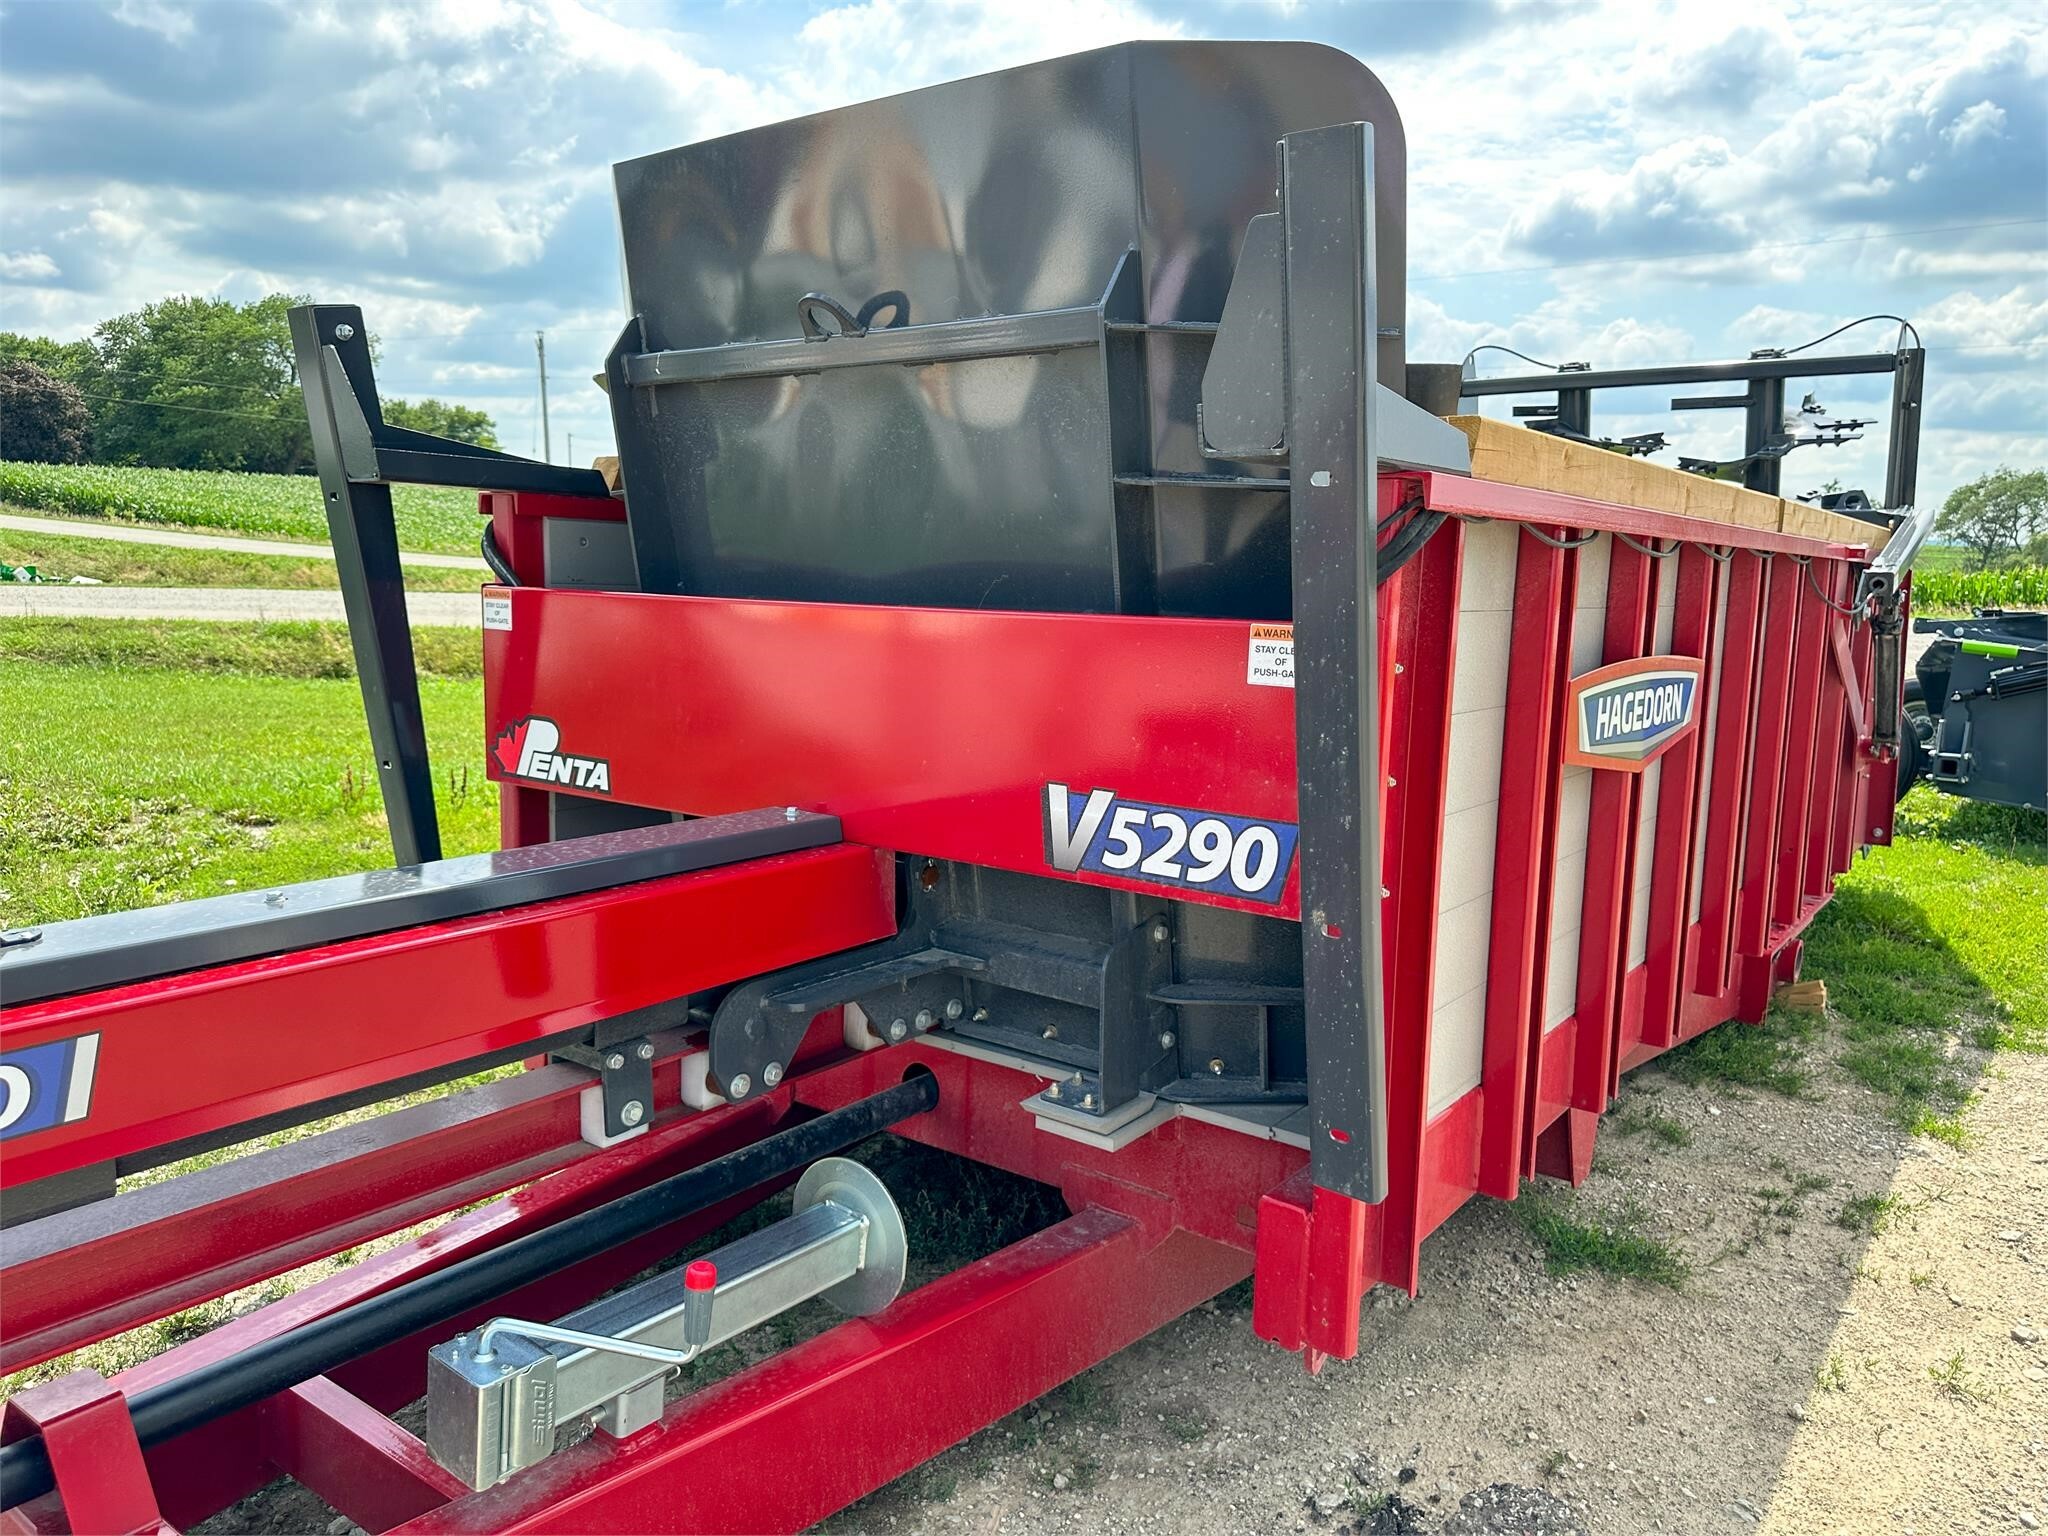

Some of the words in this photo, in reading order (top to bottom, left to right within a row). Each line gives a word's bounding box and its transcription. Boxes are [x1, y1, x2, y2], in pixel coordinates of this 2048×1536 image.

[1263, 628, 1293, 639] WARN
[1255, 645, 1277, 654] STAY
[1279, 647, 1295, 655] CLE
[1275, 658, 1287, 666] OF
[1254, 668, 1295, 678] PUSH-GA
[1595, 682, 1684, 741] HAGEDORN
[516, 718, 609, 792] PENTA
[1047, 783, 1280, 893] V5290
